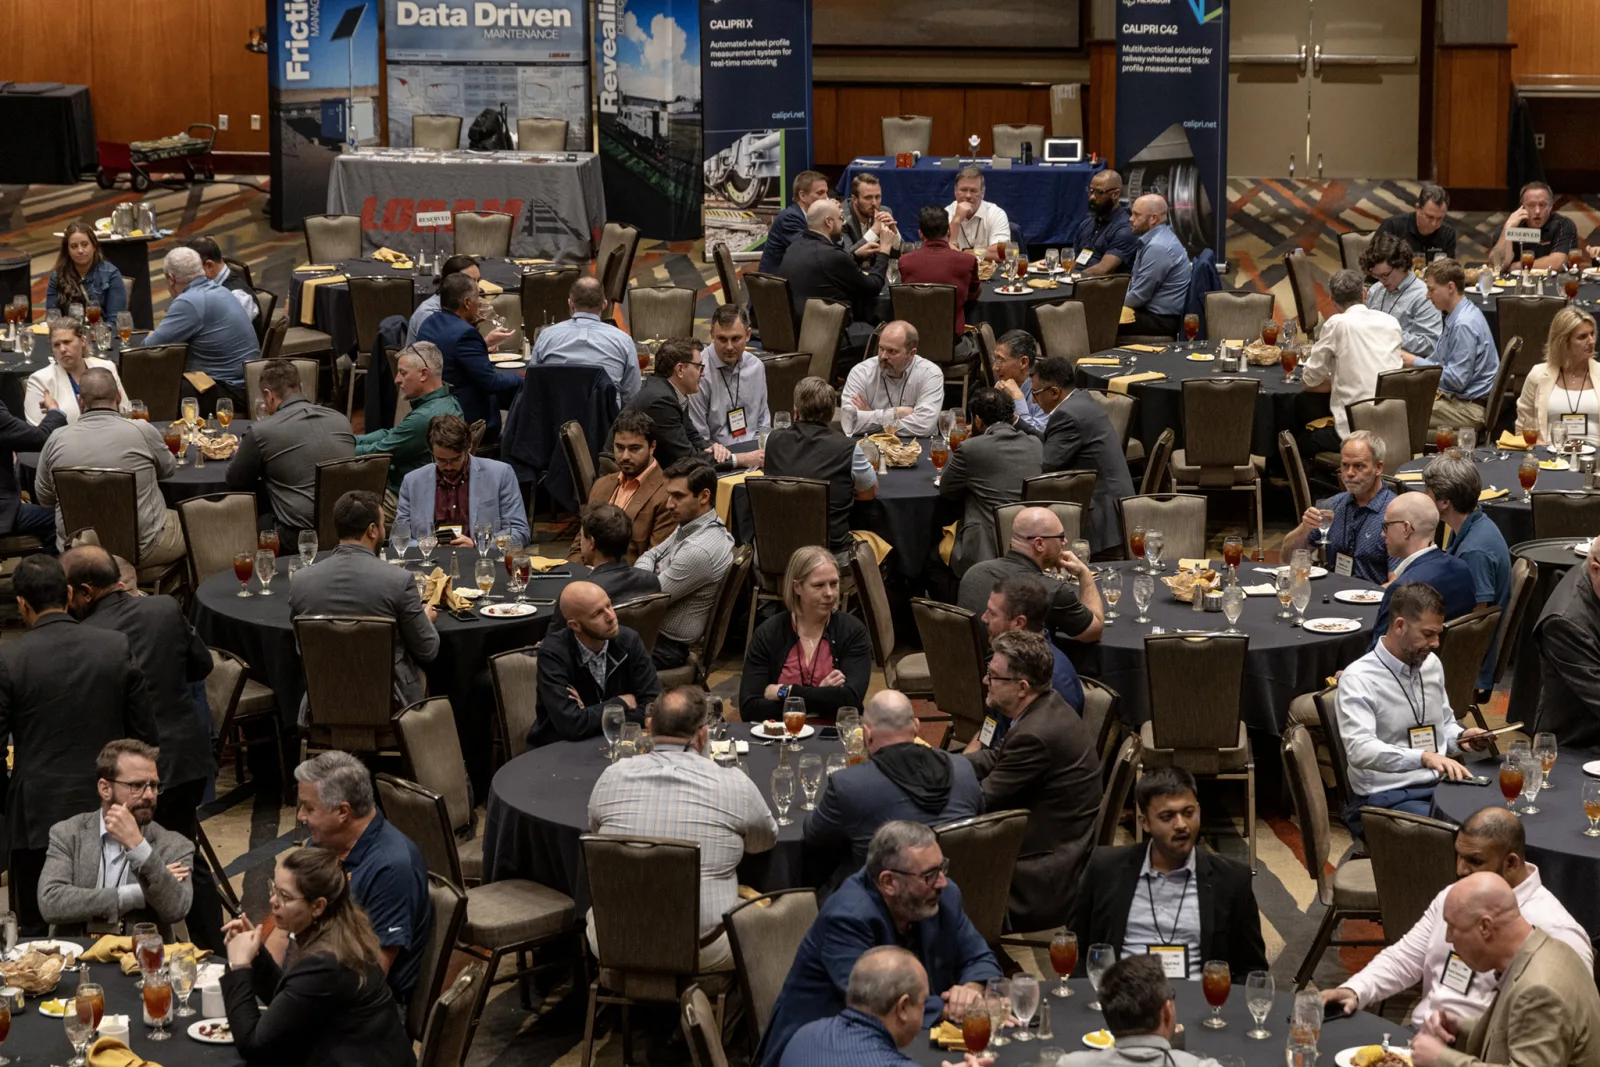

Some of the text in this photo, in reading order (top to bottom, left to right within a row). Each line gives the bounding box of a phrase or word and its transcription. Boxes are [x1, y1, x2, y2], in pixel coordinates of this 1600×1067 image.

[397, 2, 572, 27] Data Driven
[710, 19, 753, 30] CALIPRI X
[1122, 24, 1178, 35] CALIPRI C42
[484, 29, 560, 39] MAINTENANCE
[284, 0, 310, 80] Fricti
[710, 38, 790, 48] Automated wheel profile
[710, 48, 792, 58] measurement system for
[1122, 44, 1213, 55] Multifunctional solution for
[710, 58, 778, 68] real-time monitoring
[1122, 54, 1210, 64] railway wheelset and track
[1122, 64, 1192, 73] profile measurement
[772, 111, 805, 120] calipri.net
[1183, 120, 1217, 129] calipri.net
[418, 215, 451, 223] RESERVED
[1506, 231, 1540, 239] RESERVED
